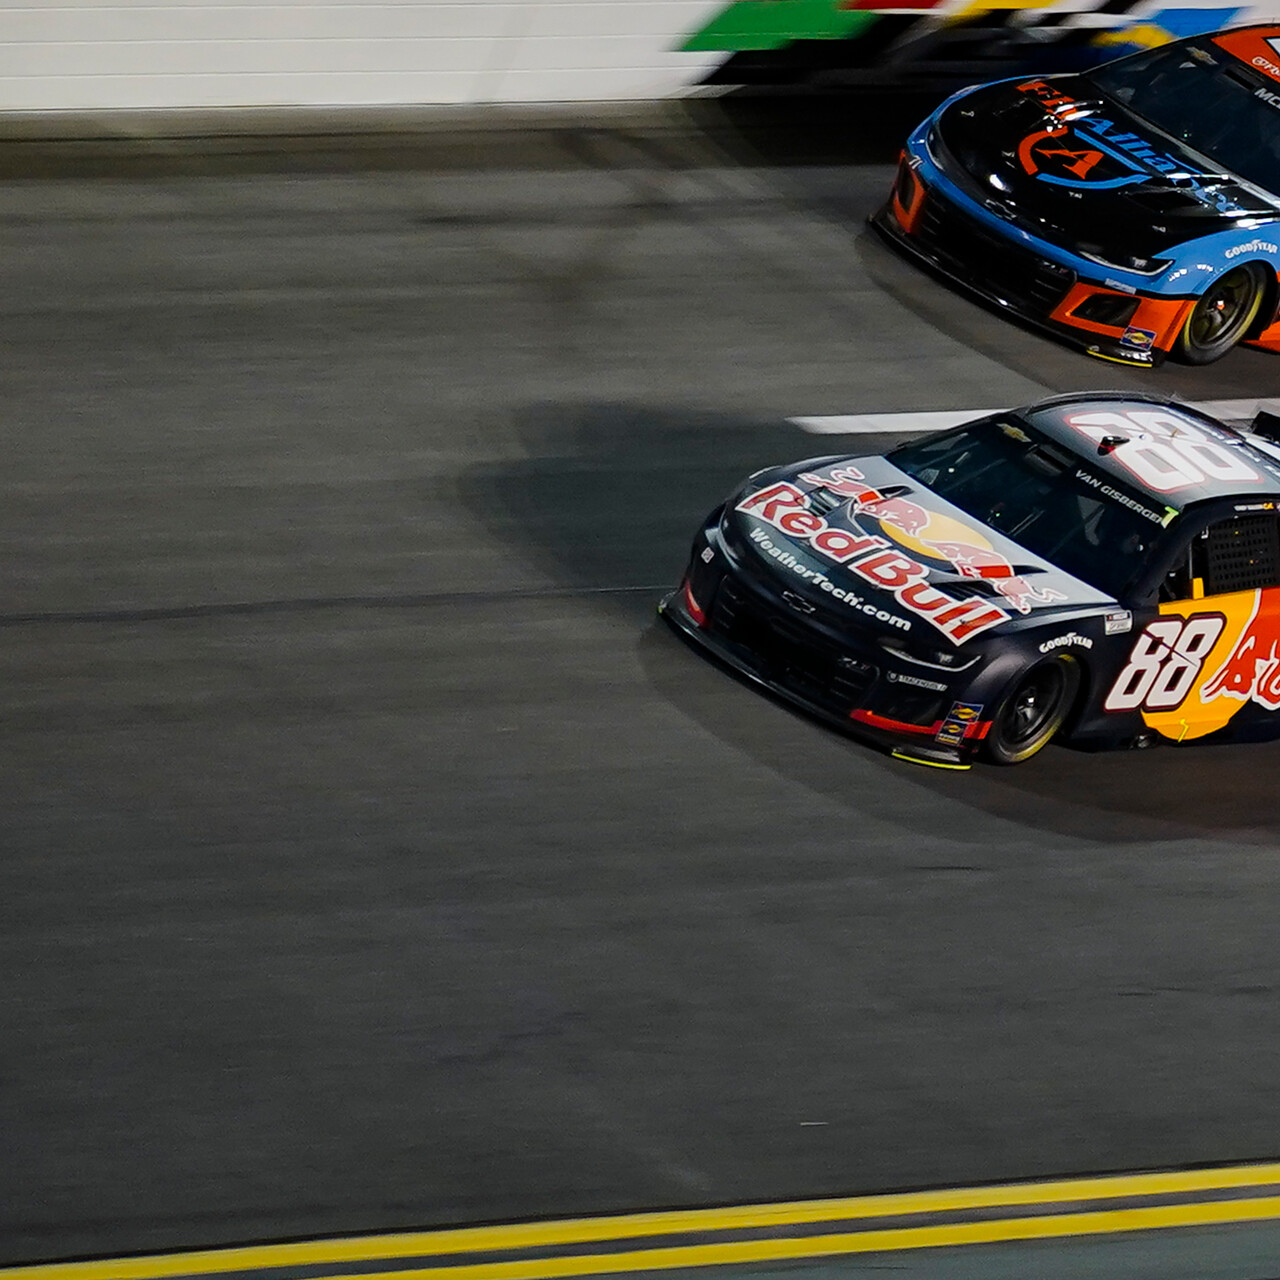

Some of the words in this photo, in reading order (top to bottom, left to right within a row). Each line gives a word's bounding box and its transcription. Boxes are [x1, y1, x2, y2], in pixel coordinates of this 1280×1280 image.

[1224, 239, 1279, 259] GOODYEAR
[1064, 410, 1264, 494] 88
[1075, 469, 1100, 489] VAN
[735, 481, 889, 564] Red
[749, 527, 912, 632] WeatherTech.com
[848, 550, 1012, 646] Bull
[1038, 632, 1093, 654] GOODYEAR
[1105, 613, 1225, 711] 88
